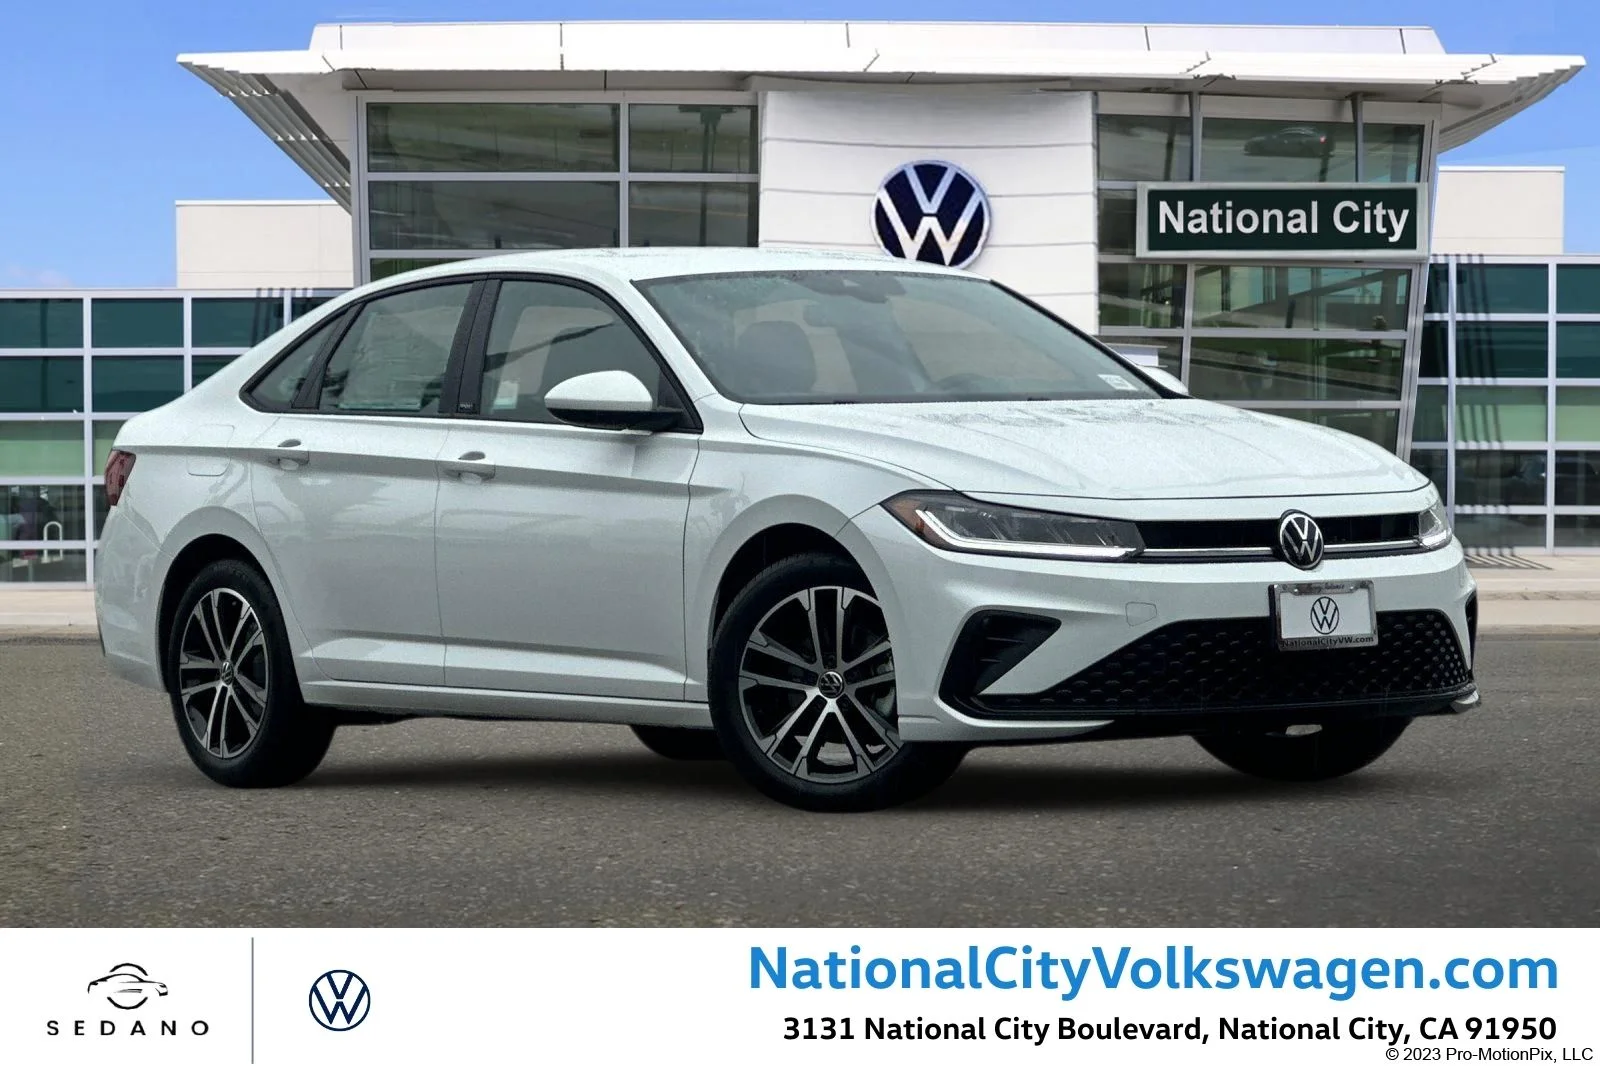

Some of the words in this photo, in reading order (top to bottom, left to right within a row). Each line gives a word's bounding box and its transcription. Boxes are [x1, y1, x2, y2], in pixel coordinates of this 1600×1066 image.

[1158, 200, 1318, 234] National
[1332, 200, 1410, 243] City
[1281, 635, 1374, 648] NationalCityVW.com
